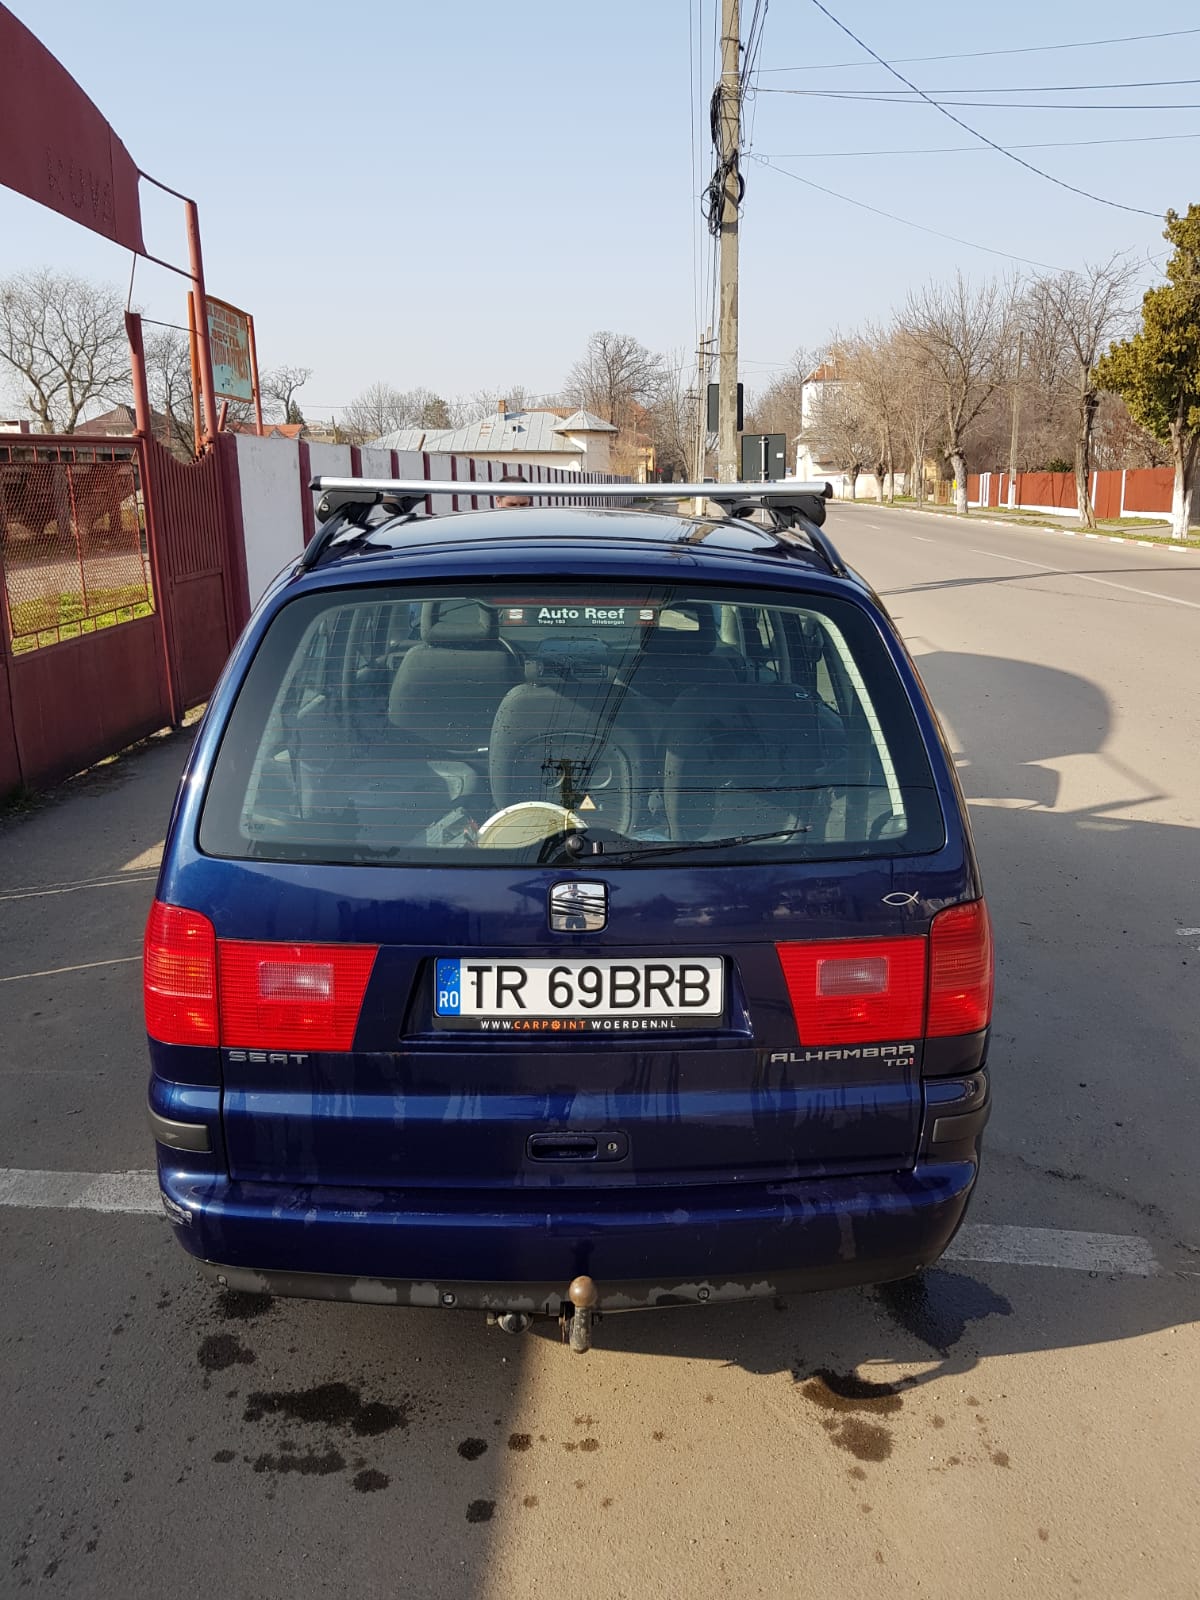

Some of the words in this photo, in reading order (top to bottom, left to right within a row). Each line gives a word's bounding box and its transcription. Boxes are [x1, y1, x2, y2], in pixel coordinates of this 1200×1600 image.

[538, 607, 579, 619] Auto
[584, 607, 625, 619] Reef
[467, 965, 527, 1009] TR
[548, 964, 710, 1009] 69BRB
[439, 991, 459, 1008] RO
[592, 1020, 676, 1029] WOERDEN.NL
[229, 1050, 309, 1064] SEAT
[770, 1045, 915, 1063] ALHAMBRA
